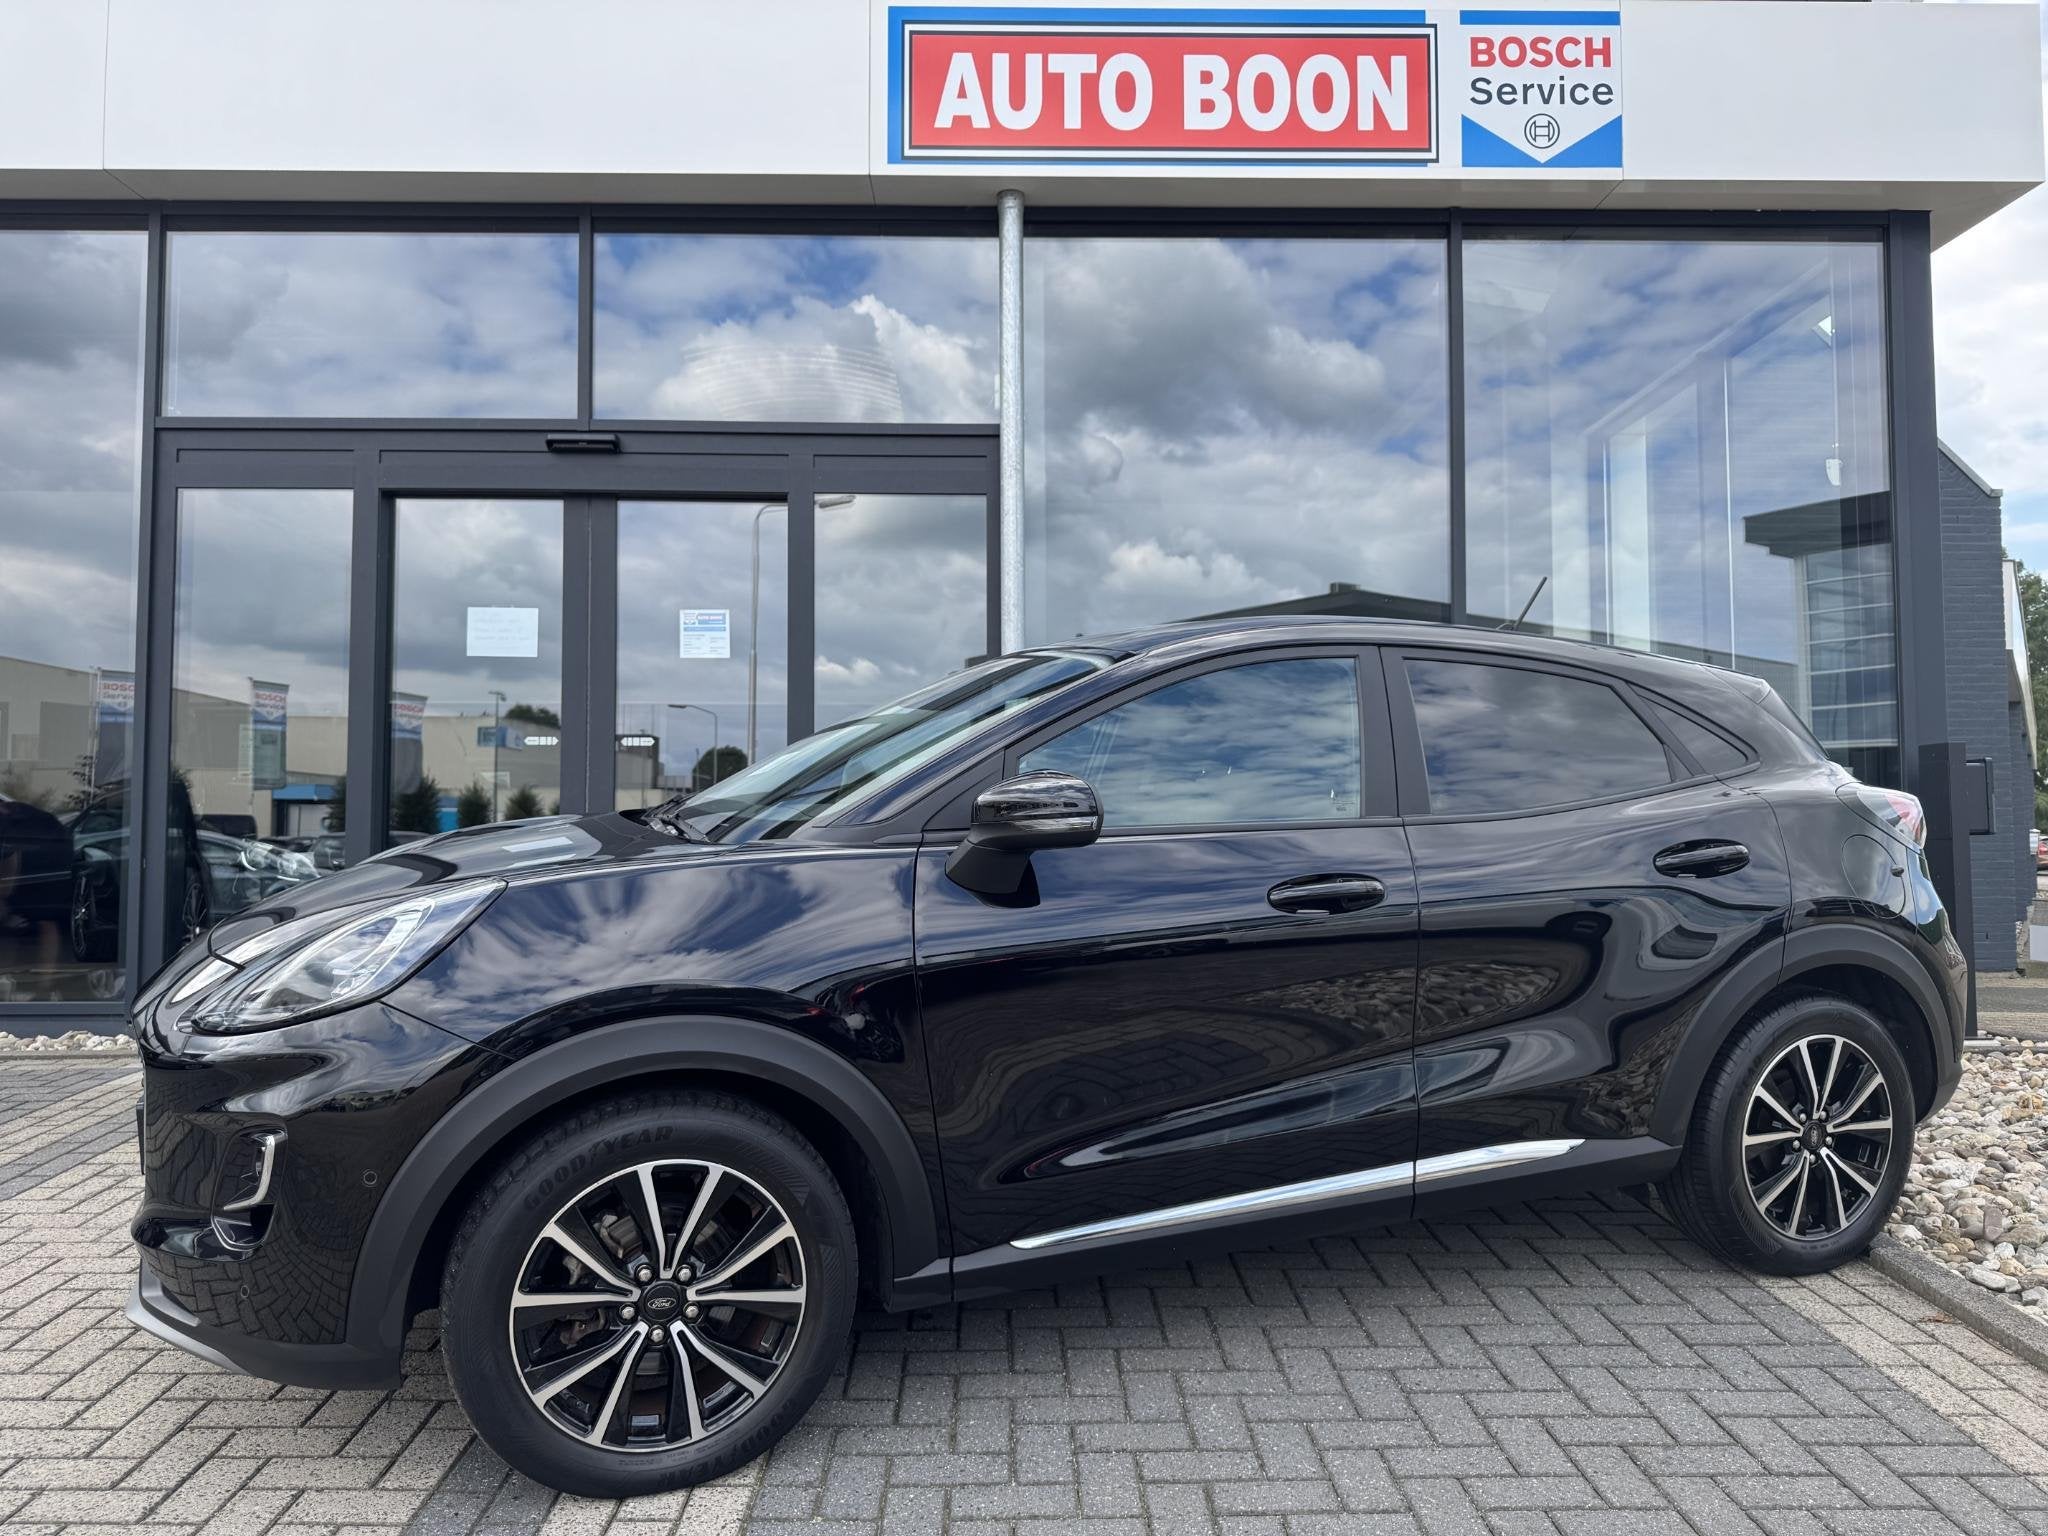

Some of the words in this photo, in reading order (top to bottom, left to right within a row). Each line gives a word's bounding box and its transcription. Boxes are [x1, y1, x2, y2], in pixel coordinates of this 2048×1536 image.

[1470, 36, 1612, 68] BOSCH
[934, 51, 1153, 132] AUTO
[1183, 53, 1409, 133] BOON
[1469, 76, 1614, 106] Service
[102, 682, 135, 691] BOSC
[255, 691, 286, 704] BOSCH
